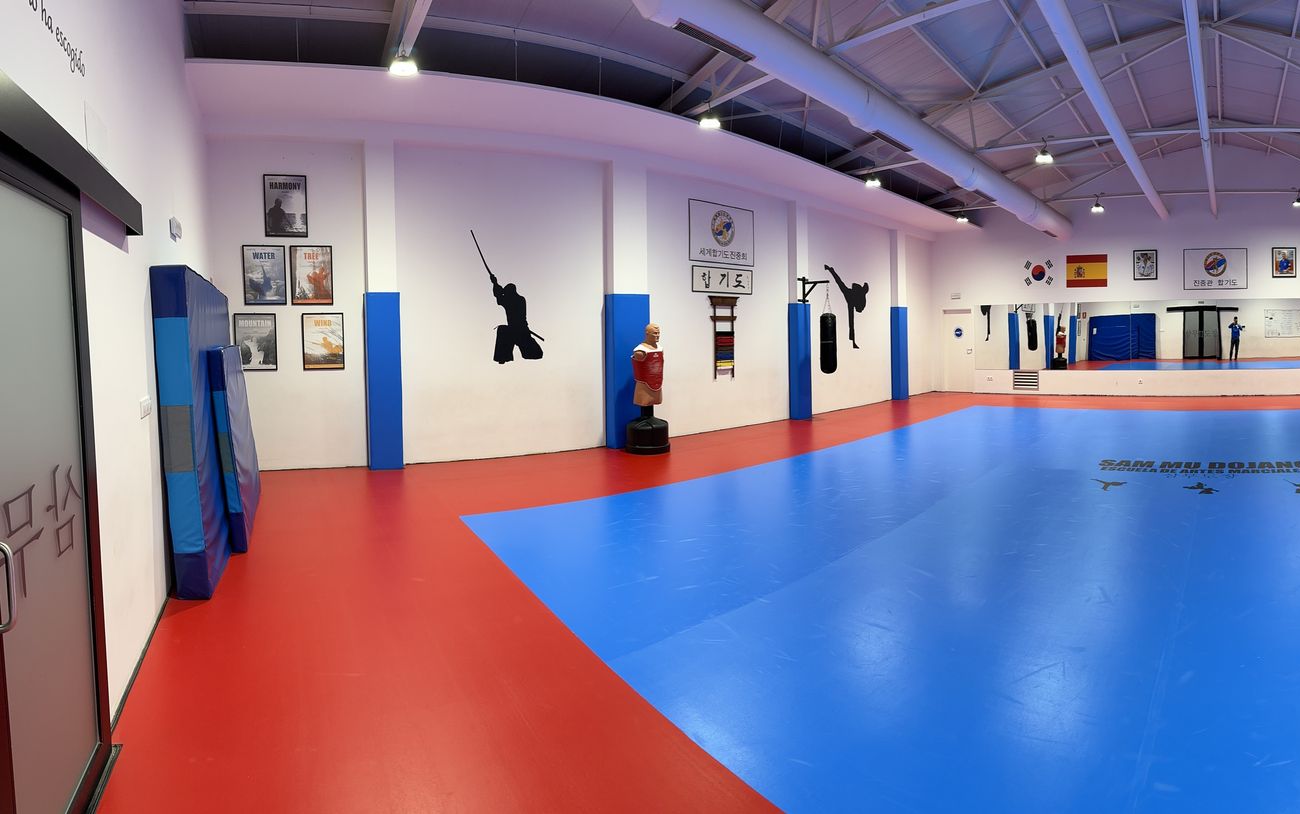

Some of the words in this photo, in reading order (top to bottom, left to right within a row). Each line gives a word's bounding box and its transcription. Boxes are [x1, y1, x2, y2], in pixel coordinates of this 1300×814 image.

[55, 26, 86, 77] escogido
[269, 181, 301, 191] HARMONY
[252, 252, 276, 260] WATER
[304, 252, 319, 260] TREE
[238, 319, 272, 328] MOUNTAIN
[314, 319, 332, 327] WIND
[1098, 459, 1155, 468] SAM
[1160, 461, 1201, 469] MU
